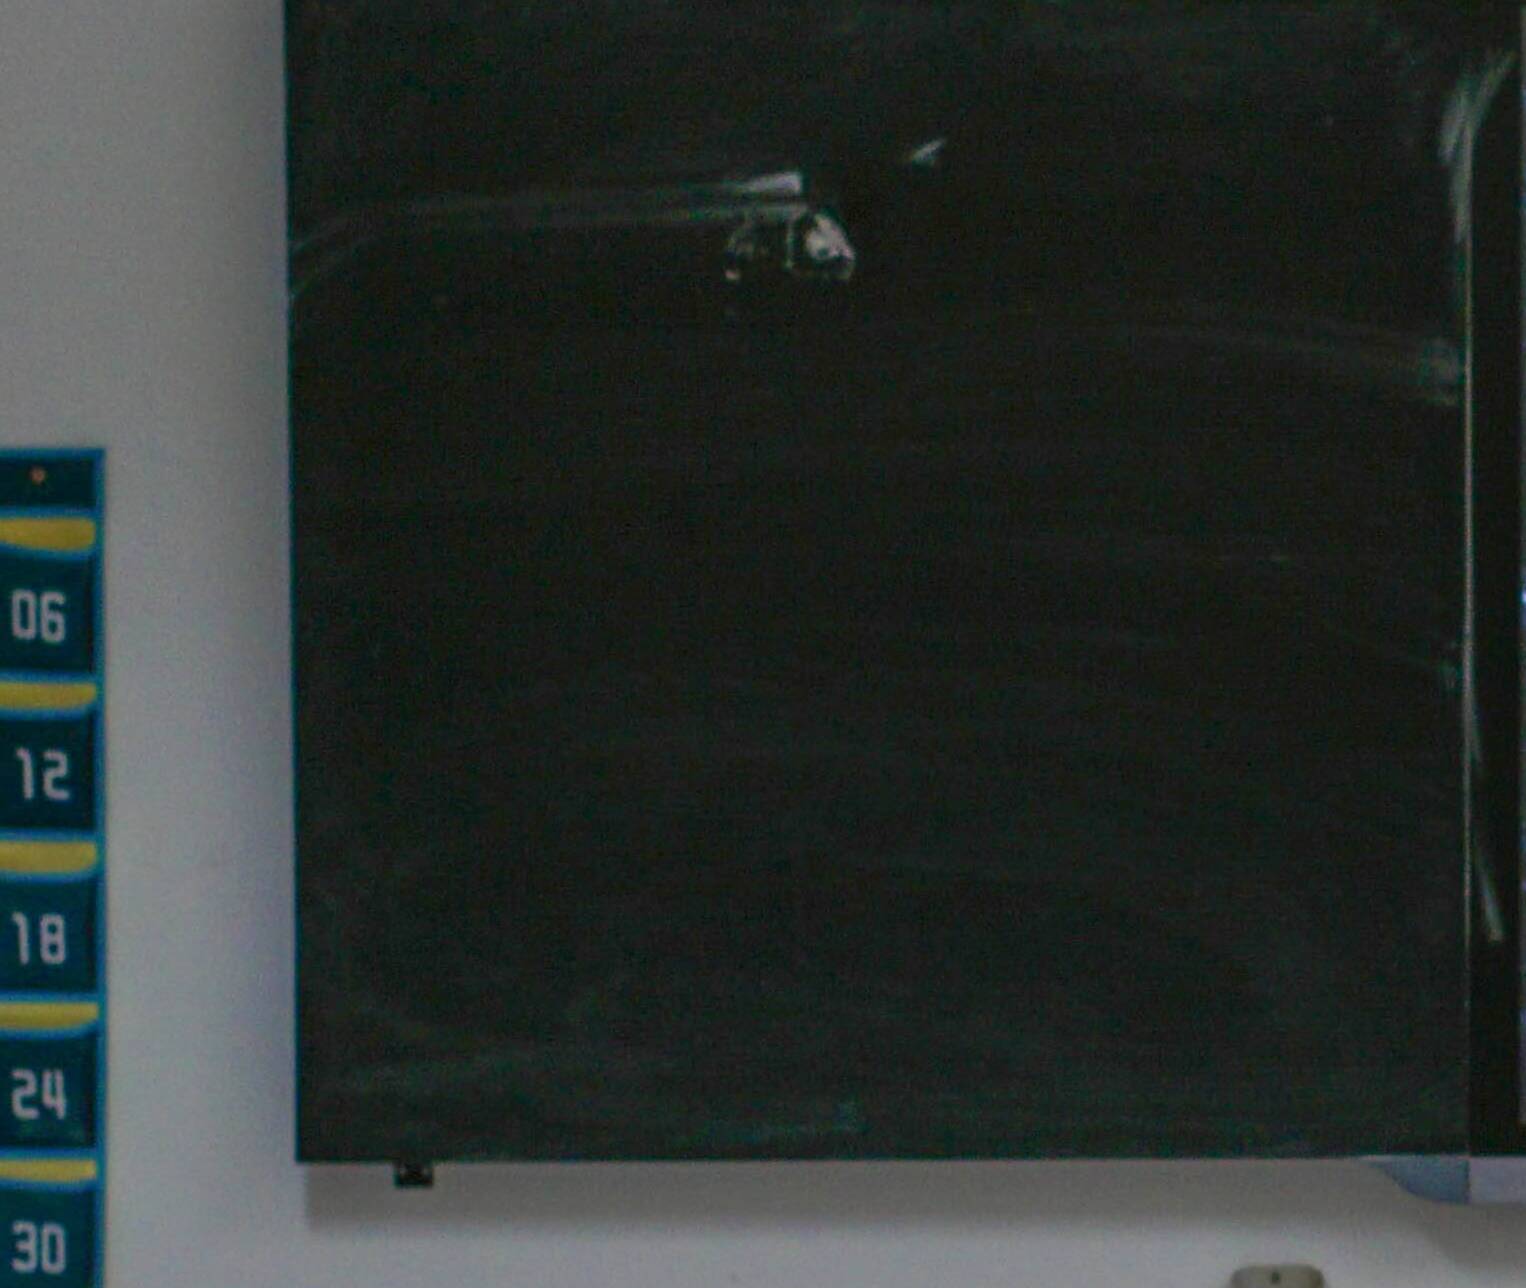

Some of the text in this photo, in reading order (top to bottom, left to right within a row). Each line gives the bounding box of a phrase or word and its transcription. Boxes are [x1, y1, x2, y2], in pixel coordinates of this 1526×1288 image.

[11, 590, 66, 643] 06
[15, 748, 70, 800] 12
[11, 912, 67, 965] 18
[11, 1068, 67, 1119] 24
[12, 1223, 66, 1275] 30
